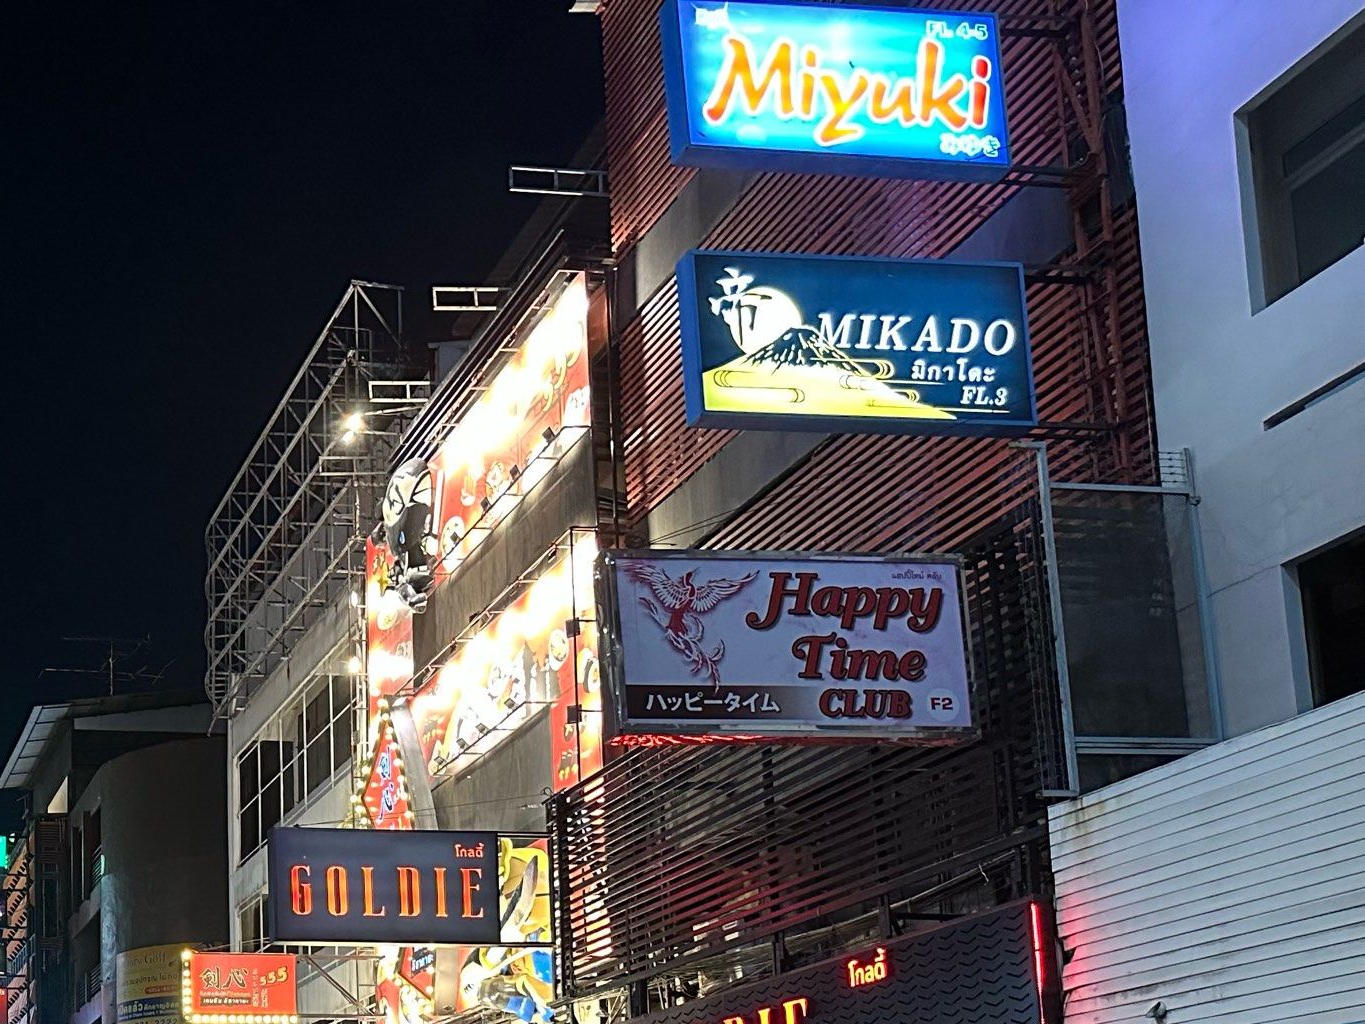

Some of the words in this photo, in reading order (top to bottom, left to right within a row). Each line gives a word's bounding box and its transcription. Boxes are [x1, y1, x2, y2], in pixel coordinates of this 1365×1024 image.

[704, 35, 990, 145] Miyuki
[817, 312, 1017, 356] MIKADO
[960, 385, 1009, 406] FL.3
[746, 571, 943, 633] Happy
[791, 632, 927, 682] Time
[645, 691, 781, 714] ハッピータイム
[819, 688, 913, 719] CLUB
[929, 696, 954, 711] F2
[290, 864, 484, 919] GOLDIE
[259, 966, 289, 987] 555
